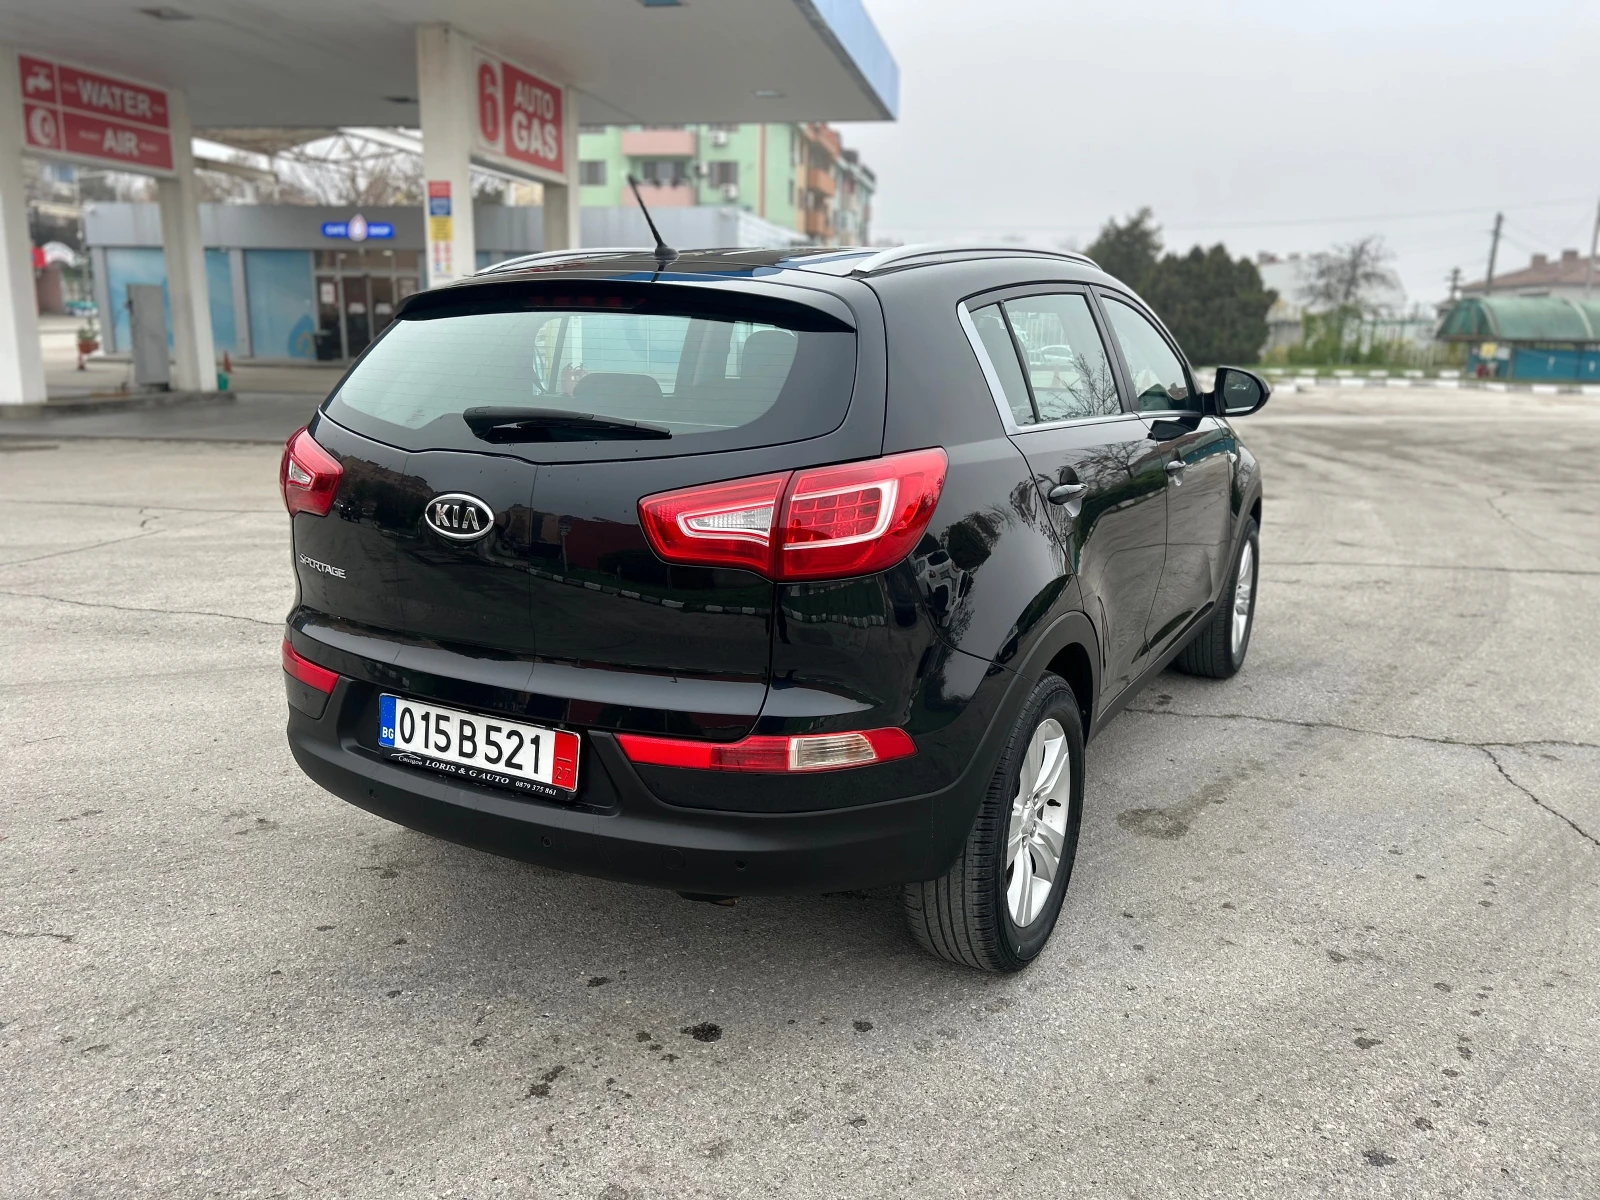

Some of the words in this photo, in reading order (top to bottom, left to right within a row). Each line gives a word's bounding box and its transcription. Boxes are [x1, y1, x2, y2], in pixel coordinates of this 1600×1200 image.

[77, 78, 152, 118] WATER
[478, 62, 499, 143] 6
[513, 80, 554, 120] AUTO
[103, 128, 139, 157] AIR
[511, 110, 557, 162] GAS
[435, 502, 480, 531] KIA
[299, 553, 346, 579] SPORTAGE
[382, 726, 394, 739] BG
[425, 760, 456, 772] LORIS
[458, 767, 466, 775] &
[468, 769, 478, 777] G
[479, 772, 509, 784] AUTO
[556, 766, 571, 781] 27
[515, 780, 531, 789] 0879
[532, 784, 544, 793] 375
[544, 787, 557, 796] 861
